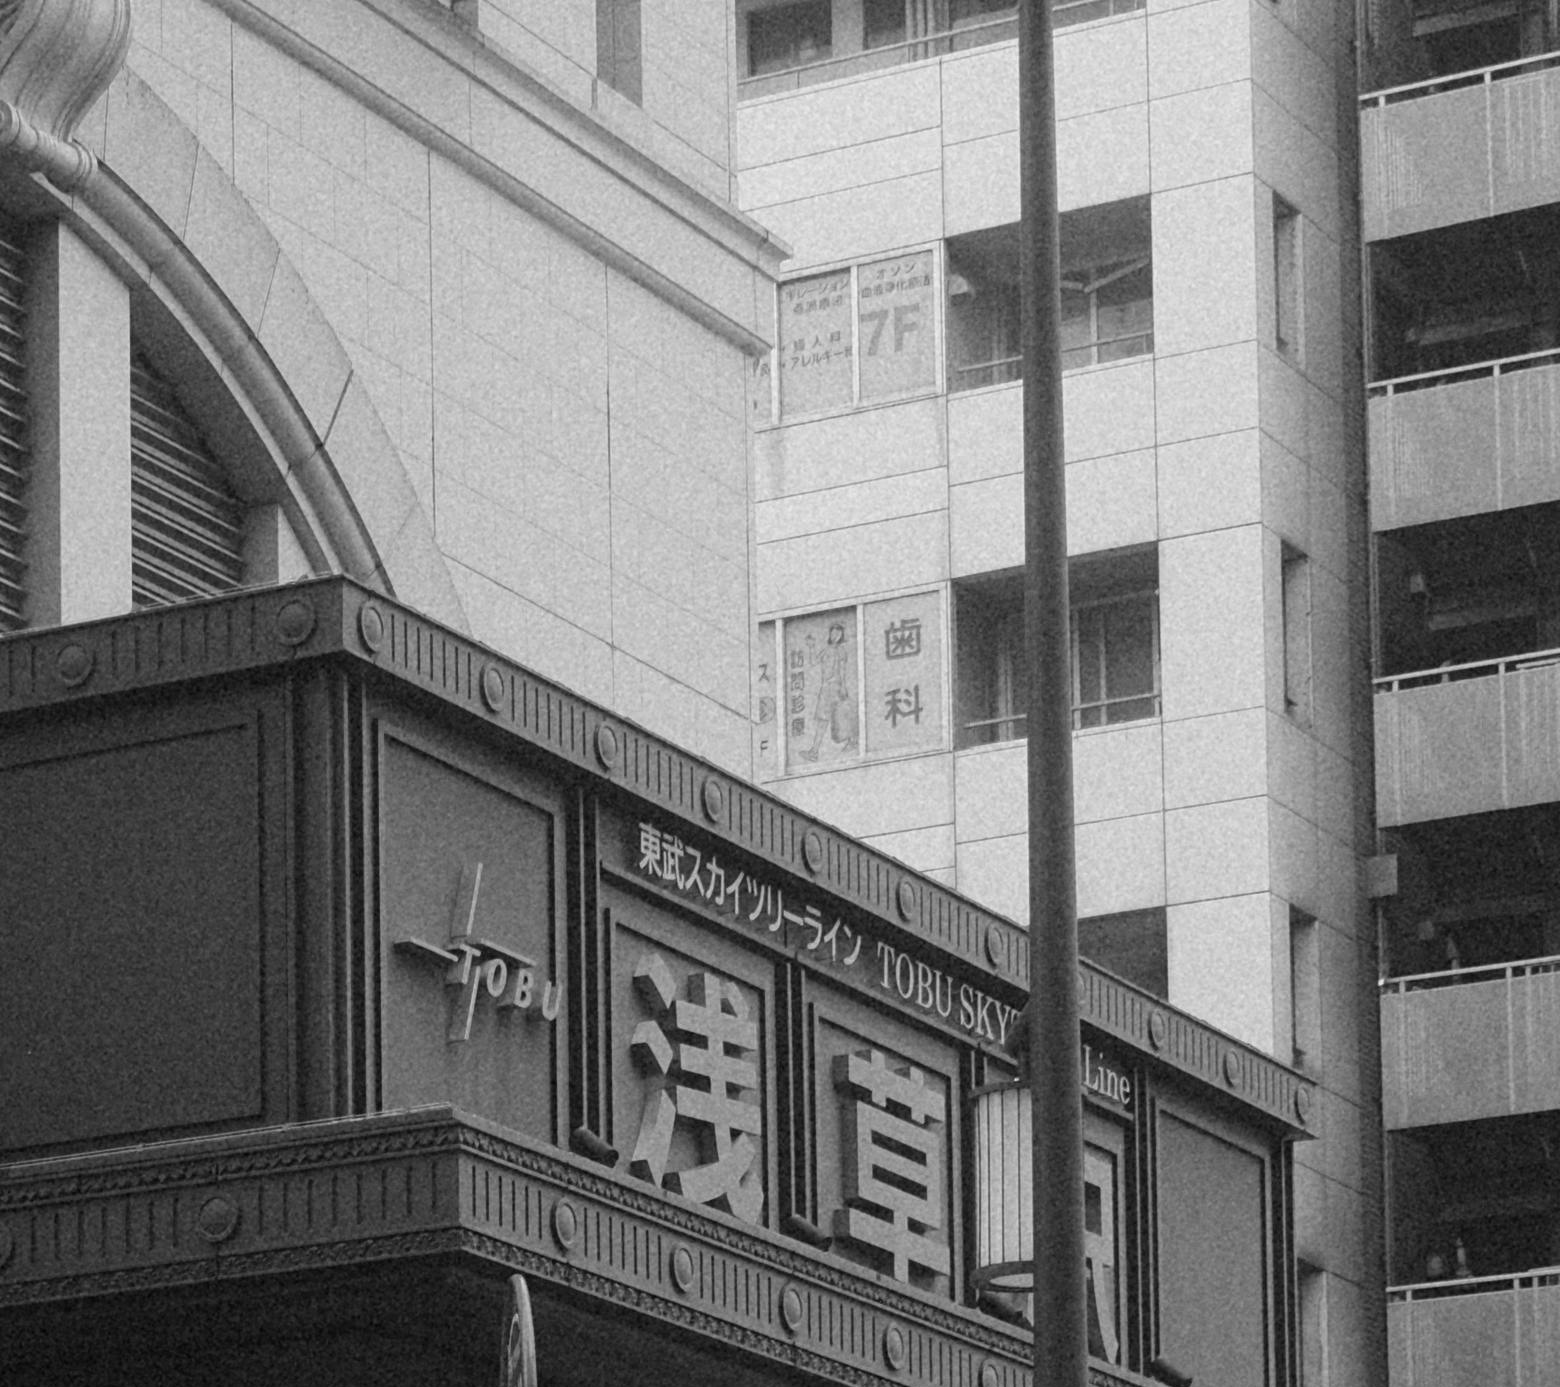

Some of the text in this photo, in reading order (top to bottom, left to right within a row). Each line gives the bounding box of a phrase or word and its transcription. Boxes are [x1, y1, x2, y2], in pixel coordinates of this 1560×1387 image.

[861, 302, 920, 356] 7F
[884, 617, 924, 729] 歯科
[638, 821, 862, 966] 東武スカイツリーライン
[459, 943, 563, 1021] TOBU
[878, 940, 952, 1018] TOBU
